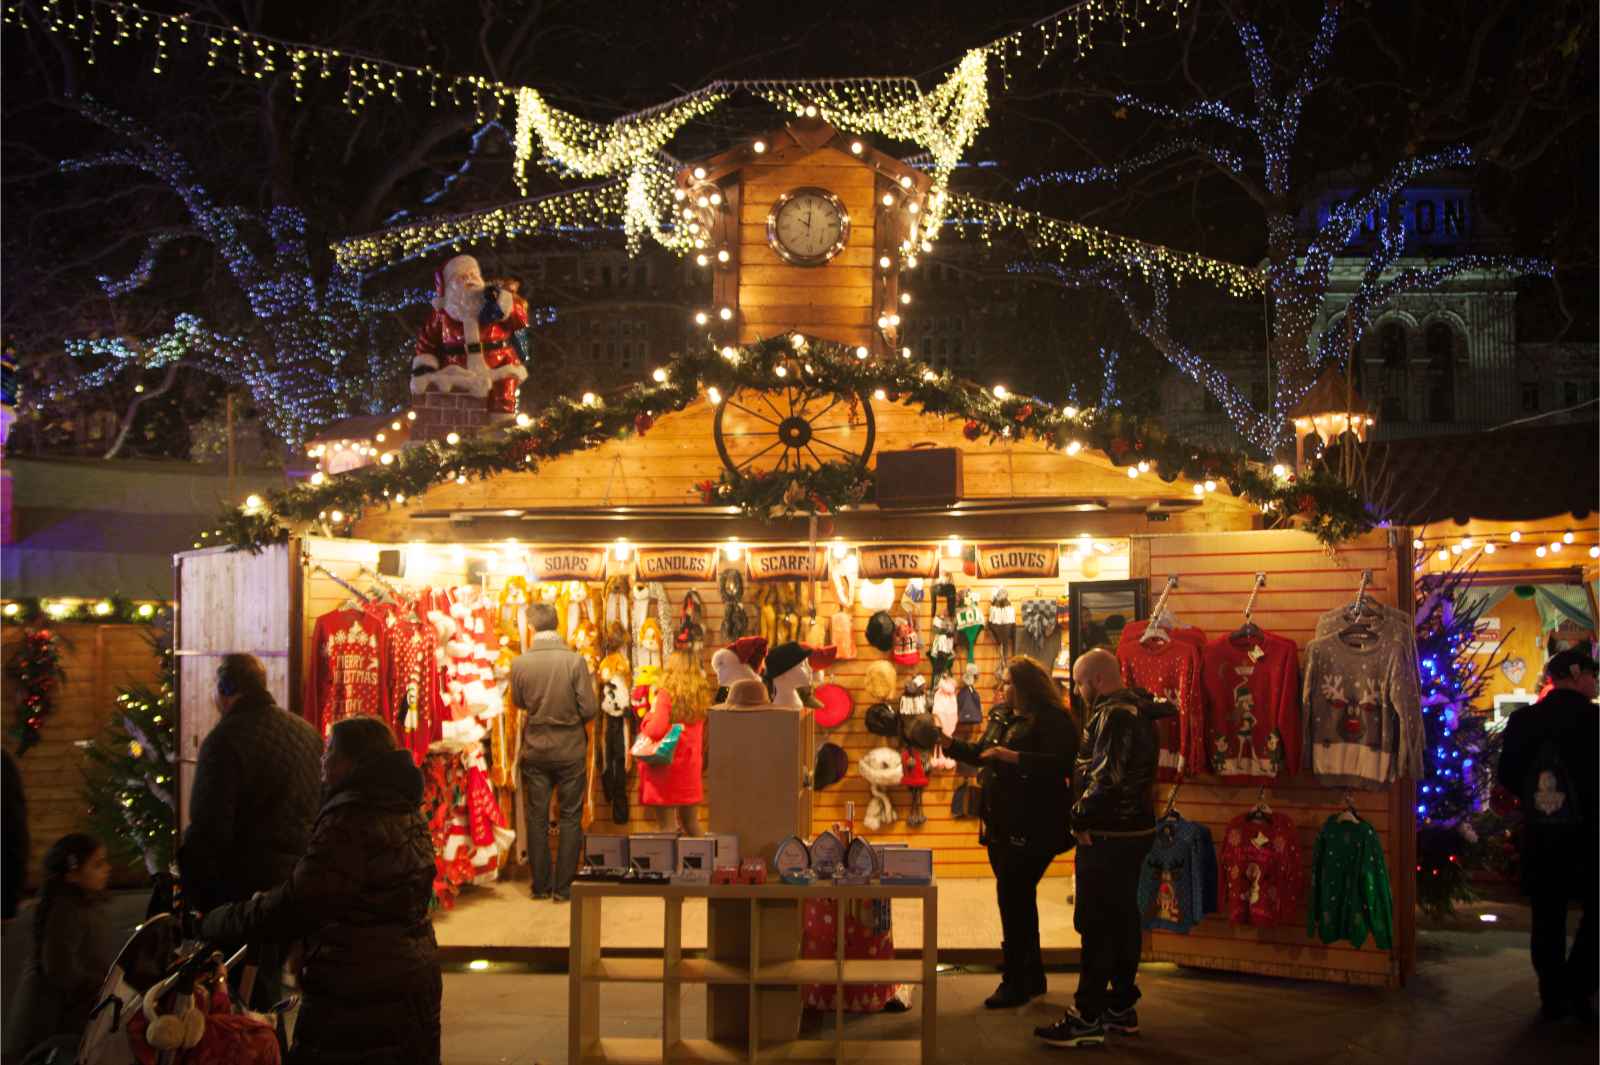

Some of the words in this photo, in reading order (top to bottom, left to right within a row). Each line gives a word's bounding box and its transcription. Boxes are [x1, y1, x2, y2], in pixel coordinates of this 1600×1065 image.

[545, 555, 589, 572] SOAPS
[647, 555, 706, 573] CANDLES
[878, 553, 919, 569] HATS
[990, 551, 1046, 569] GLOVES
